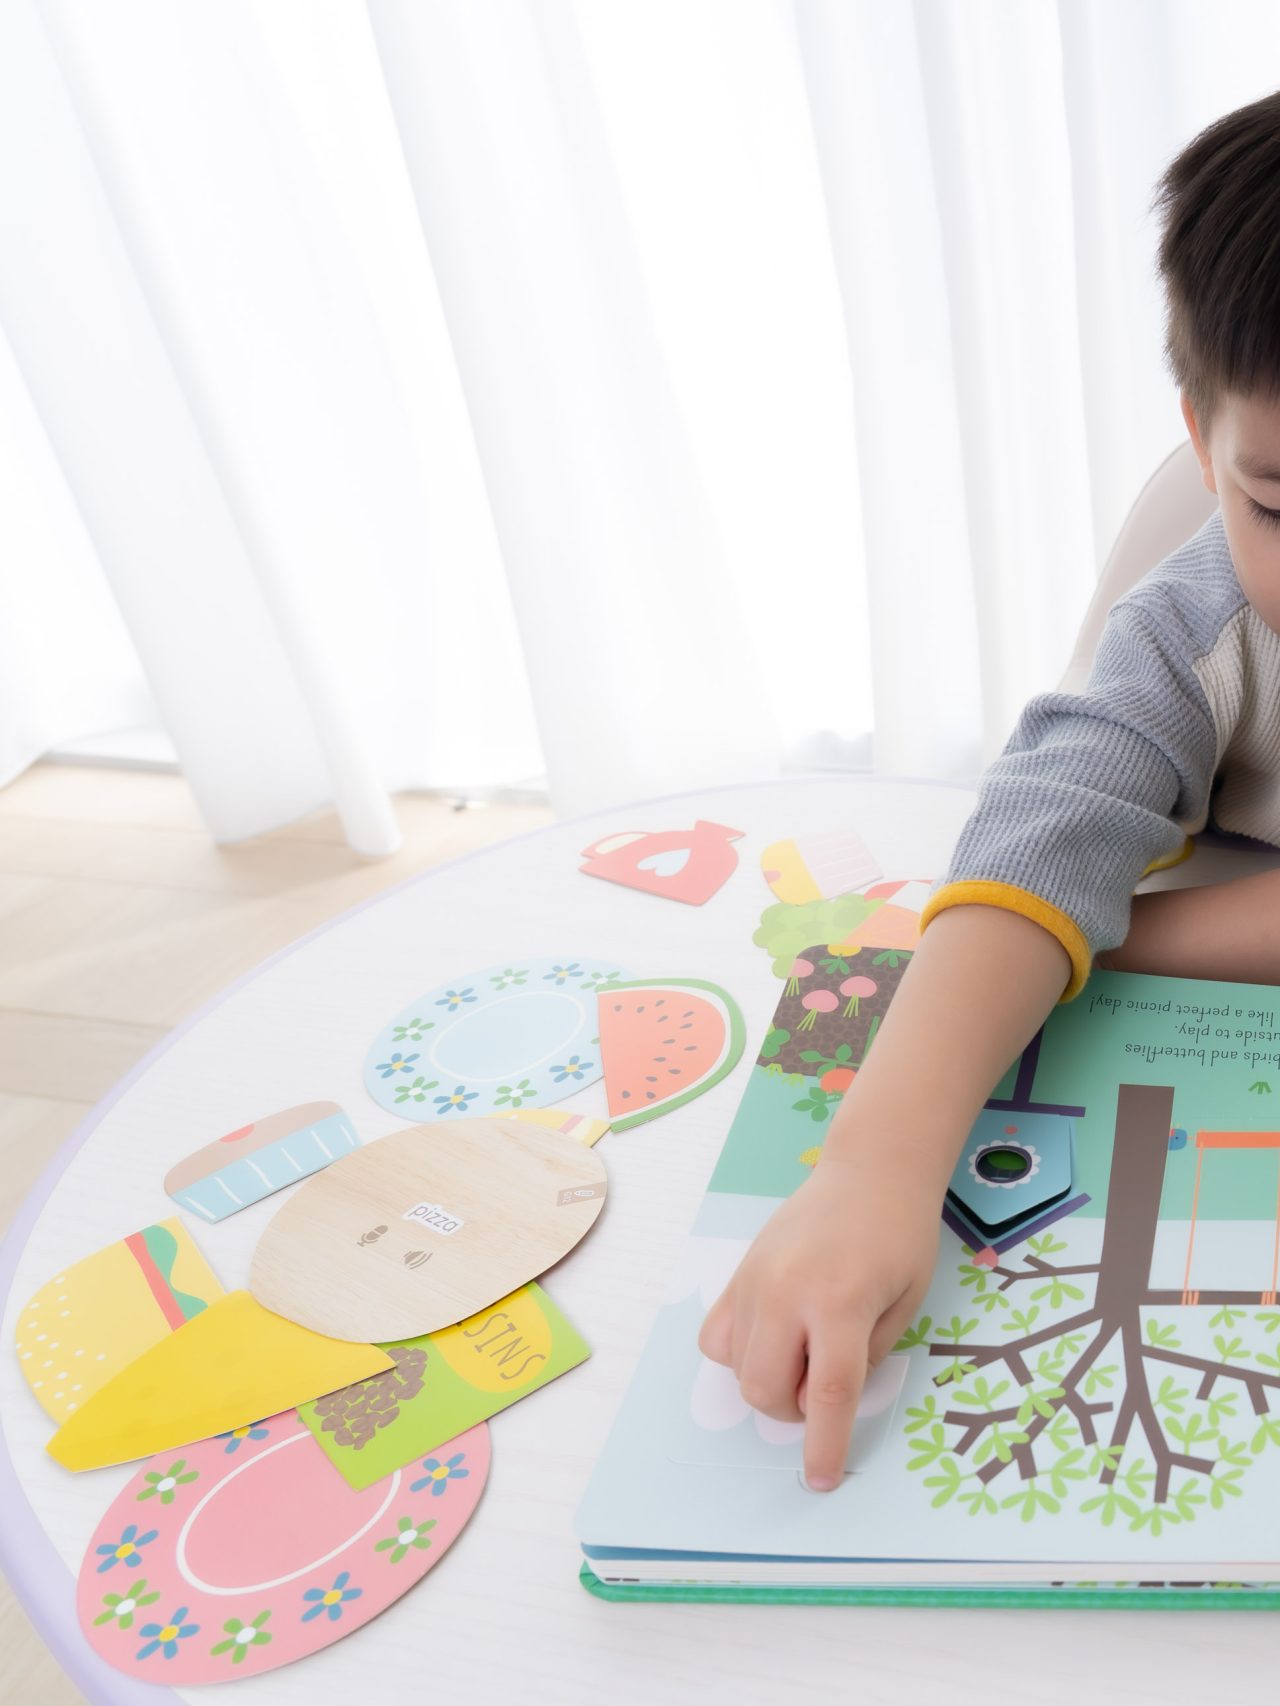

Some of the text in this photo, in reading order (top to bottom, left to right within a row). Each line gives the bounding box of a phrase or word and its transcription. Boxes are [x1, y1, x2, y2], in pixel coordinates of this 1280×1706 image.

[1089, 993, 1122, 1015] day!
[1126, 1000, 1171, 1014] picnic
[1175, 1004, 1230, 1023] perfect
[1235, 1009, 1243, 1018] a
[1247, 1009, 1275, 1028] like
[1174, 1022, 1210, 1044] play.
[1215, 1028, 1231, 1039] to
[1124, 1043, 1206, 1066] butterflies
[1210, 1050, 1239, 1067] and
[407, 1205, 460, 1232] pizza
[456, 1312, 547, 1381] SINS
